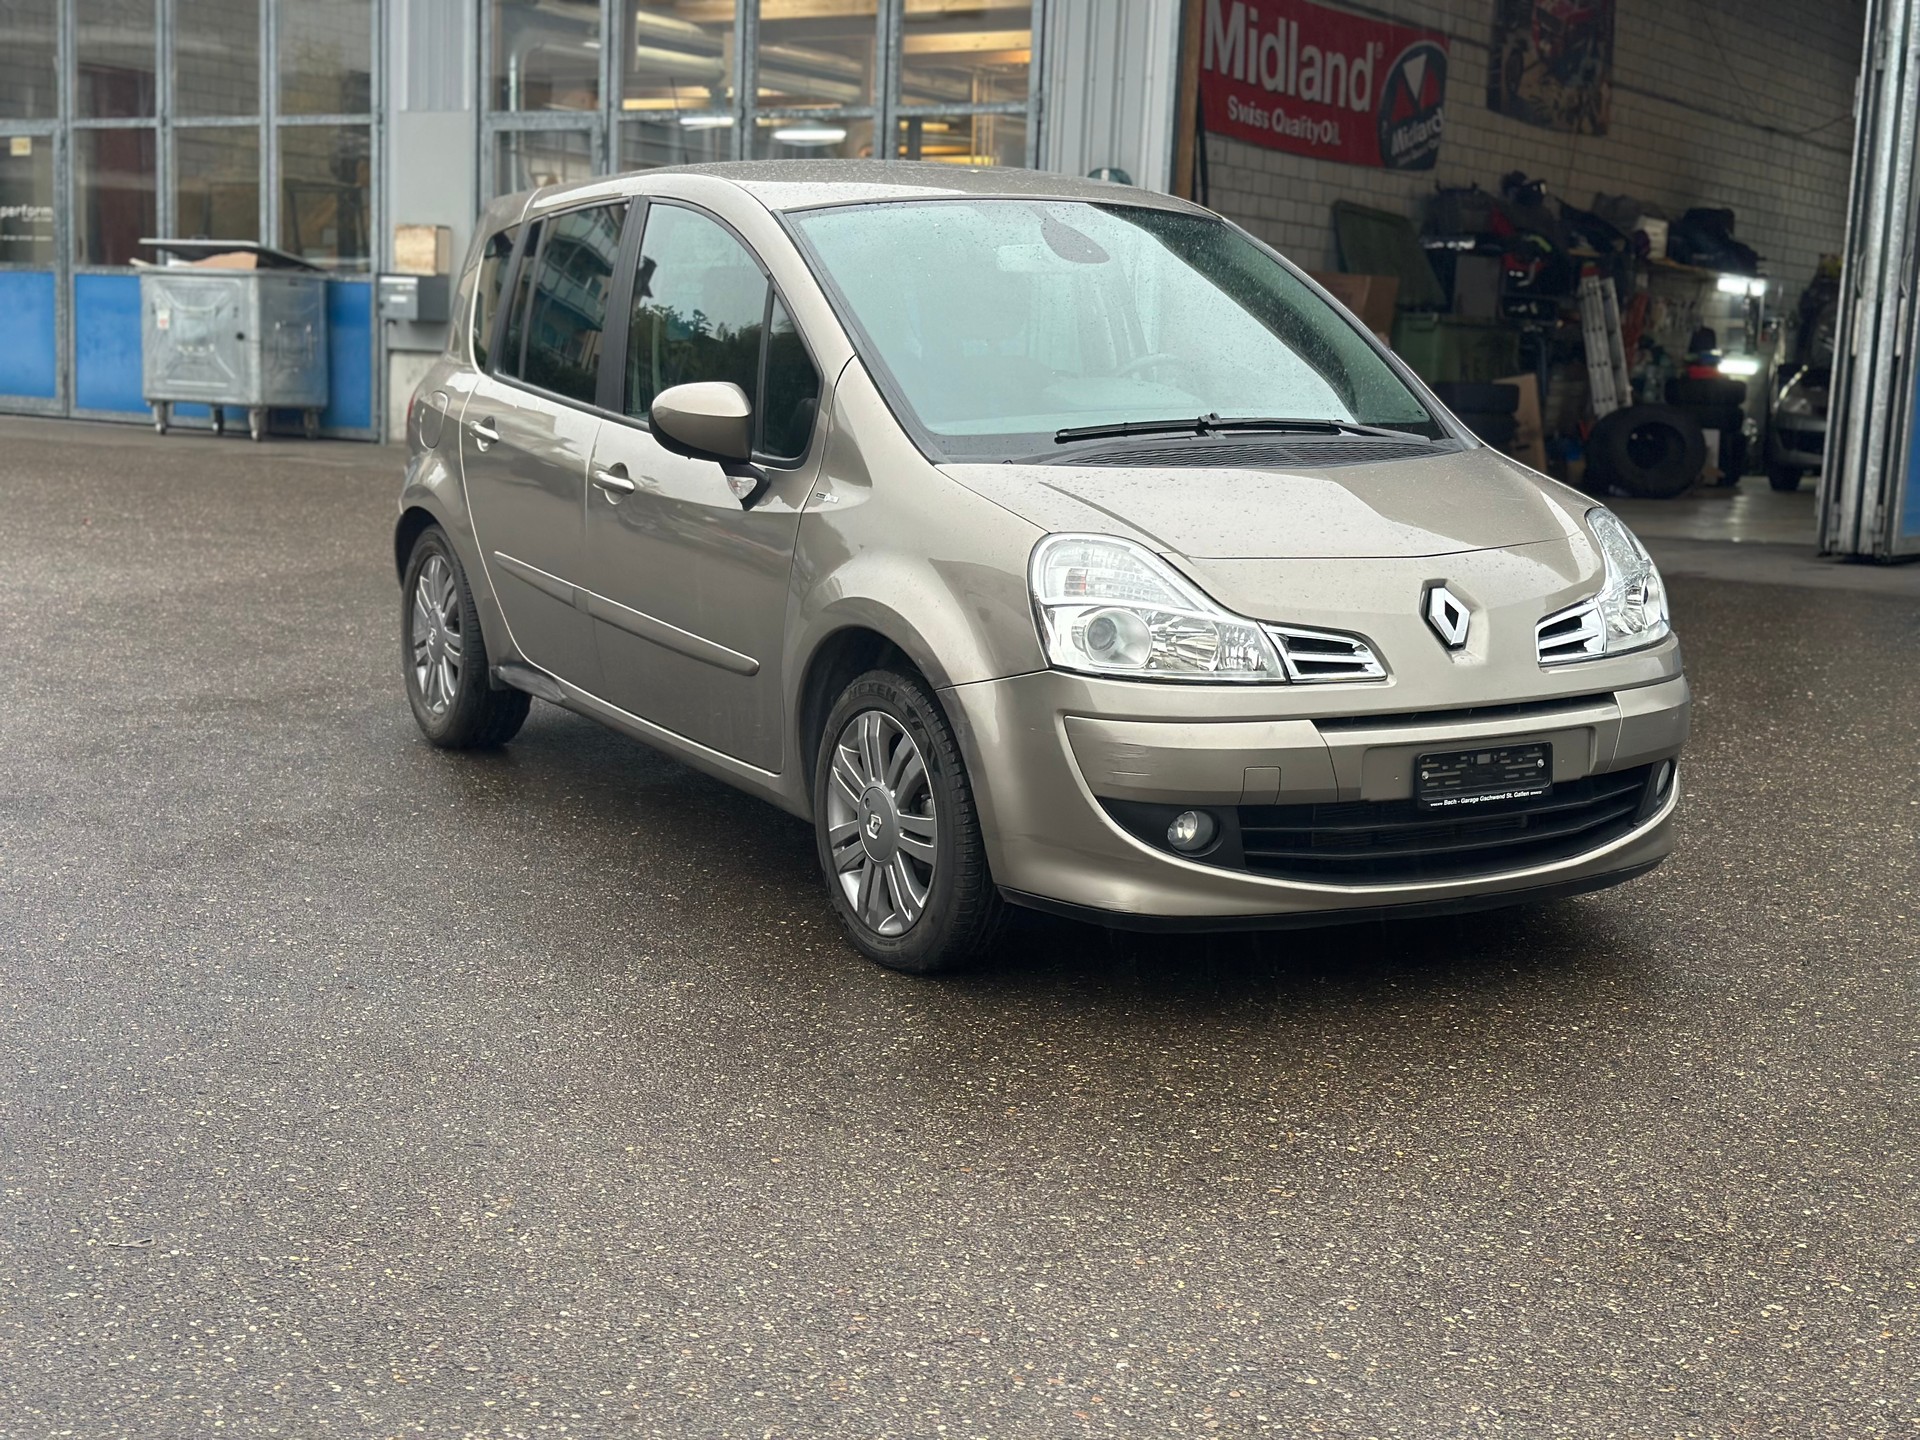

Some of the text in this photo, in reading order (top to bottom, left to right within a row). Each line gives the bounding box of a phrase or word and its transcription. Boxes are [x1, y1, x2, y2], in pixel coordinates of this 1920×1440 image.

[1203, 0, 1375, 113] Midland
[1227, 95, 1270, 130] Swiss
[1514, 790, 1530, 798] Gallen
